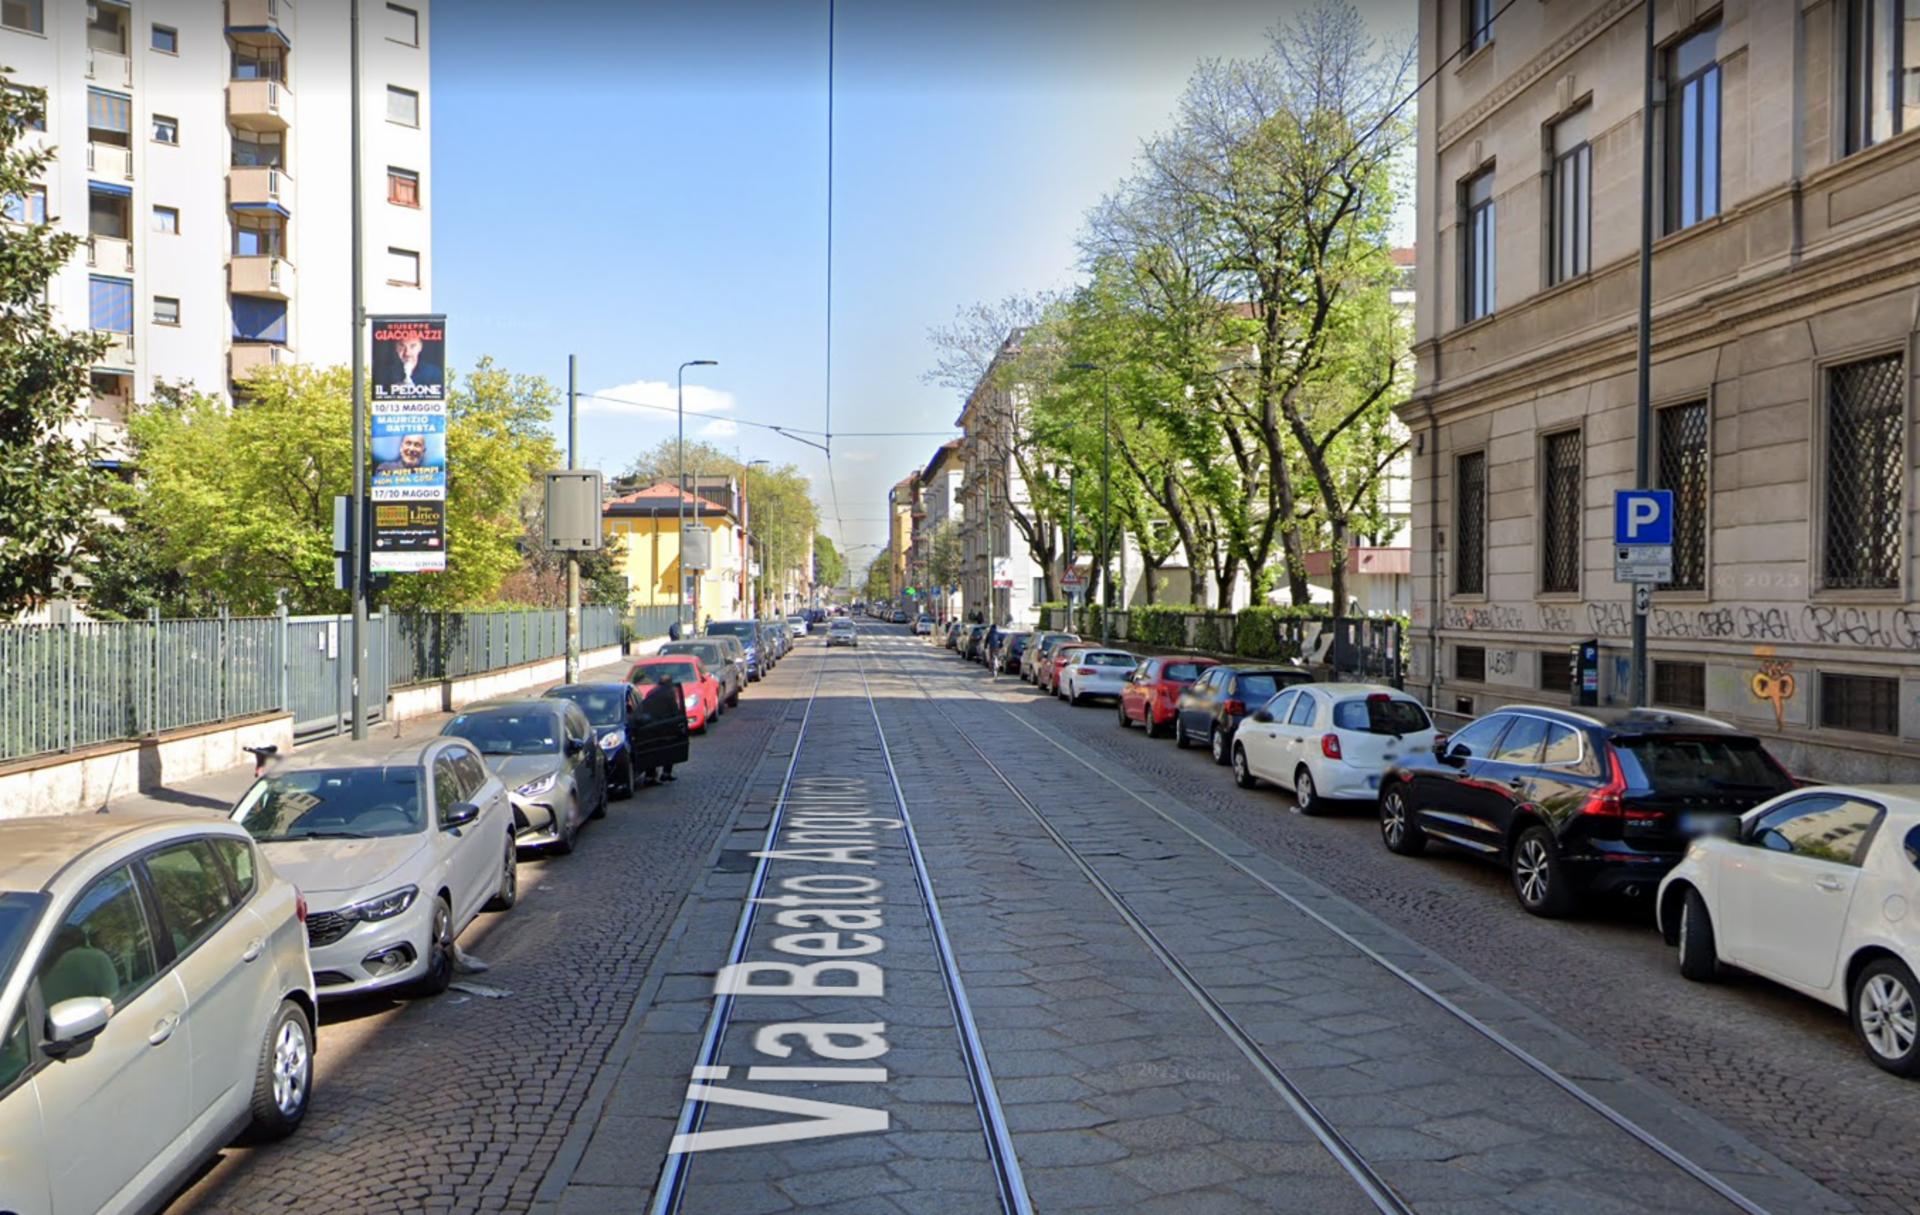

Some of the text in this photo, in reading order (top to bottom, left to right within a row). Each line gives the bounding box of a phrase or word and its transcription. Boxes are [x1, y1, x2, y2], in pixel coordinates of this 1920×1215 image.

[375, 330, 442, 340] GIACOBAZZI
[375, 385, 441, 395] IL PEDONE
[375, 404, 441, 412] 10/13 MAGGIO
[377, 416, 429, 424] MAURIZIO
[386, 424, 436, 432] BATTISTA
[402, 489, 440, 497] MAGGIO
[410, 510, 440, 520] Lirico
[1627, 497, 1660, 538] P
[1801, 605, 1891, 648] CRASH
[1586, 647, 1595, 659] P
